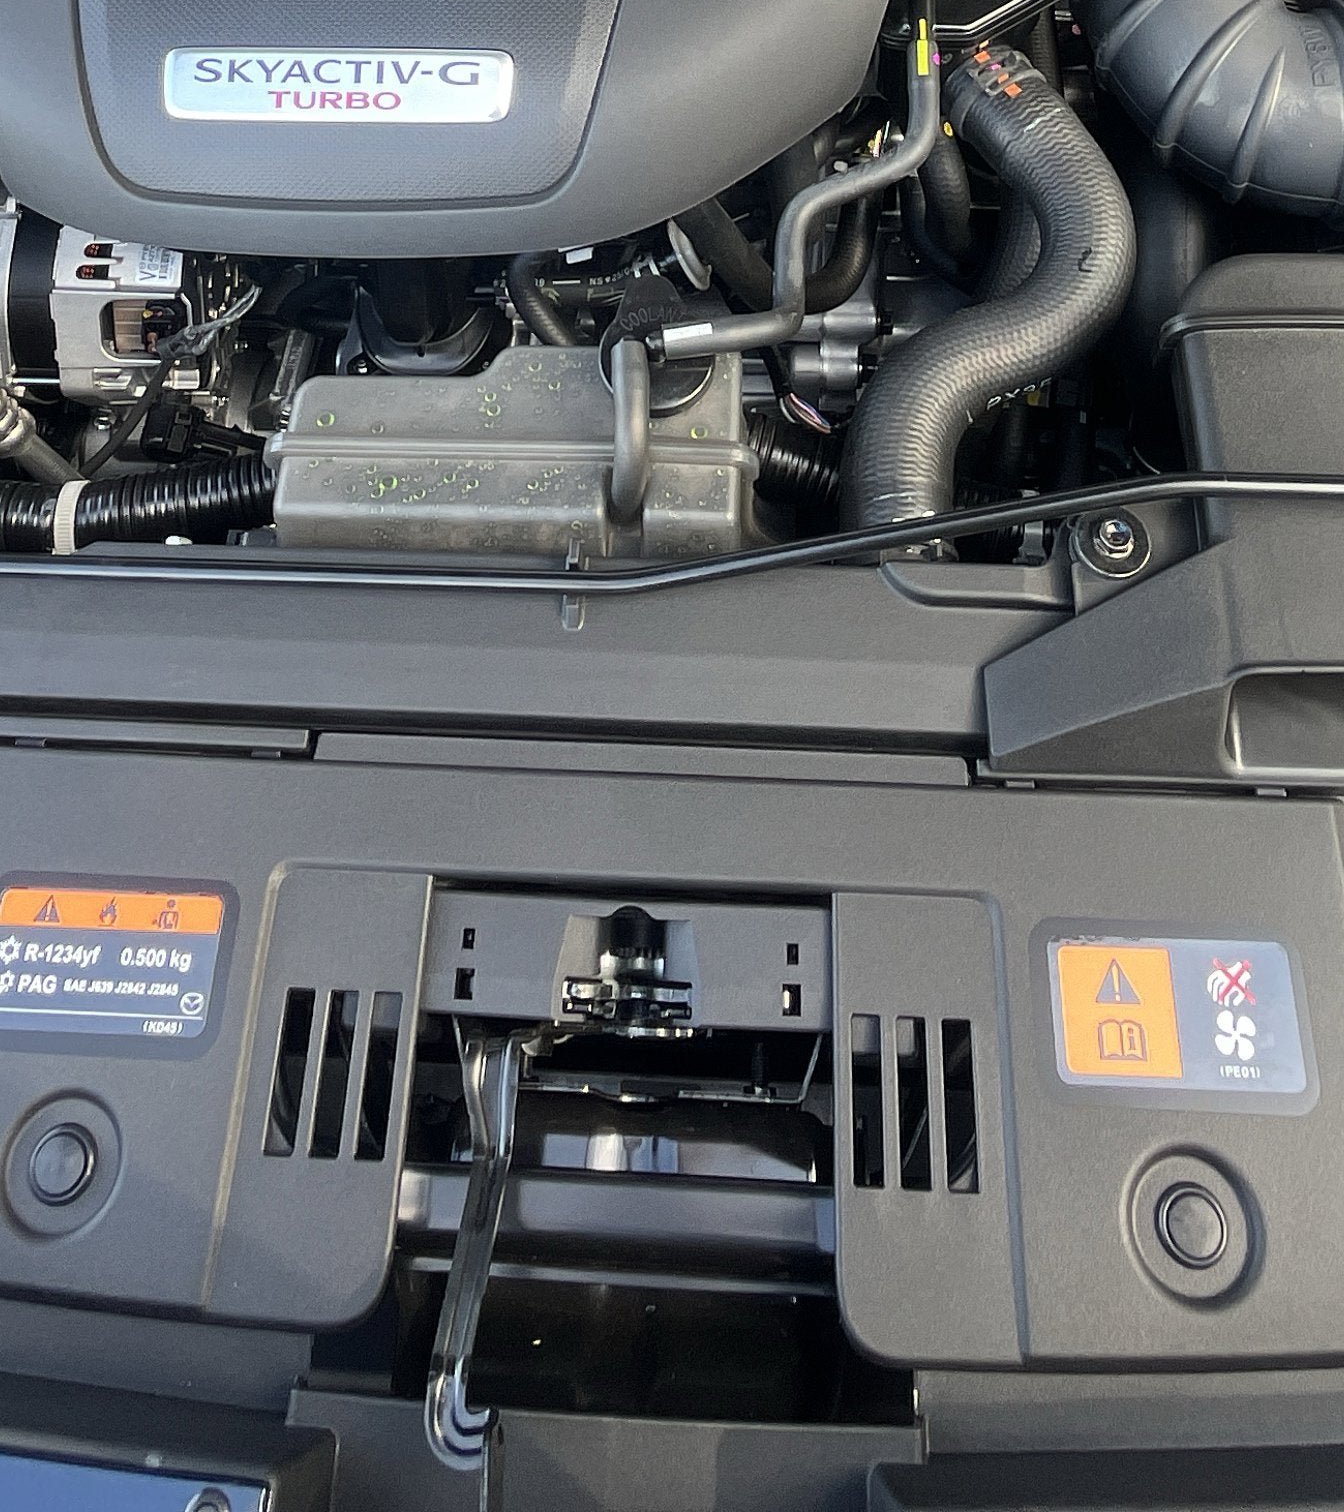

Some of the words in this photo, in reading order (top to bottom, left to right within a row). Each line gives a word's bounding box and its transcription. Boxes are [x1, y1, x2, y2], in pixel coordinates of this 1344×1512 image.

[193, 58, 481, 86] SKYACTIV-G
[267, 90, 402, 110] TURBO
[24, 943, 102, 968] R-1234yf
[120, 947, 166, 967] 0.500
[169, 948, 193, 972] kg
[17, 974, 57, 994] PAG
[63, 978, 87, 992] SAE
[1220, 1066, 1260, 1079] (PE01)
